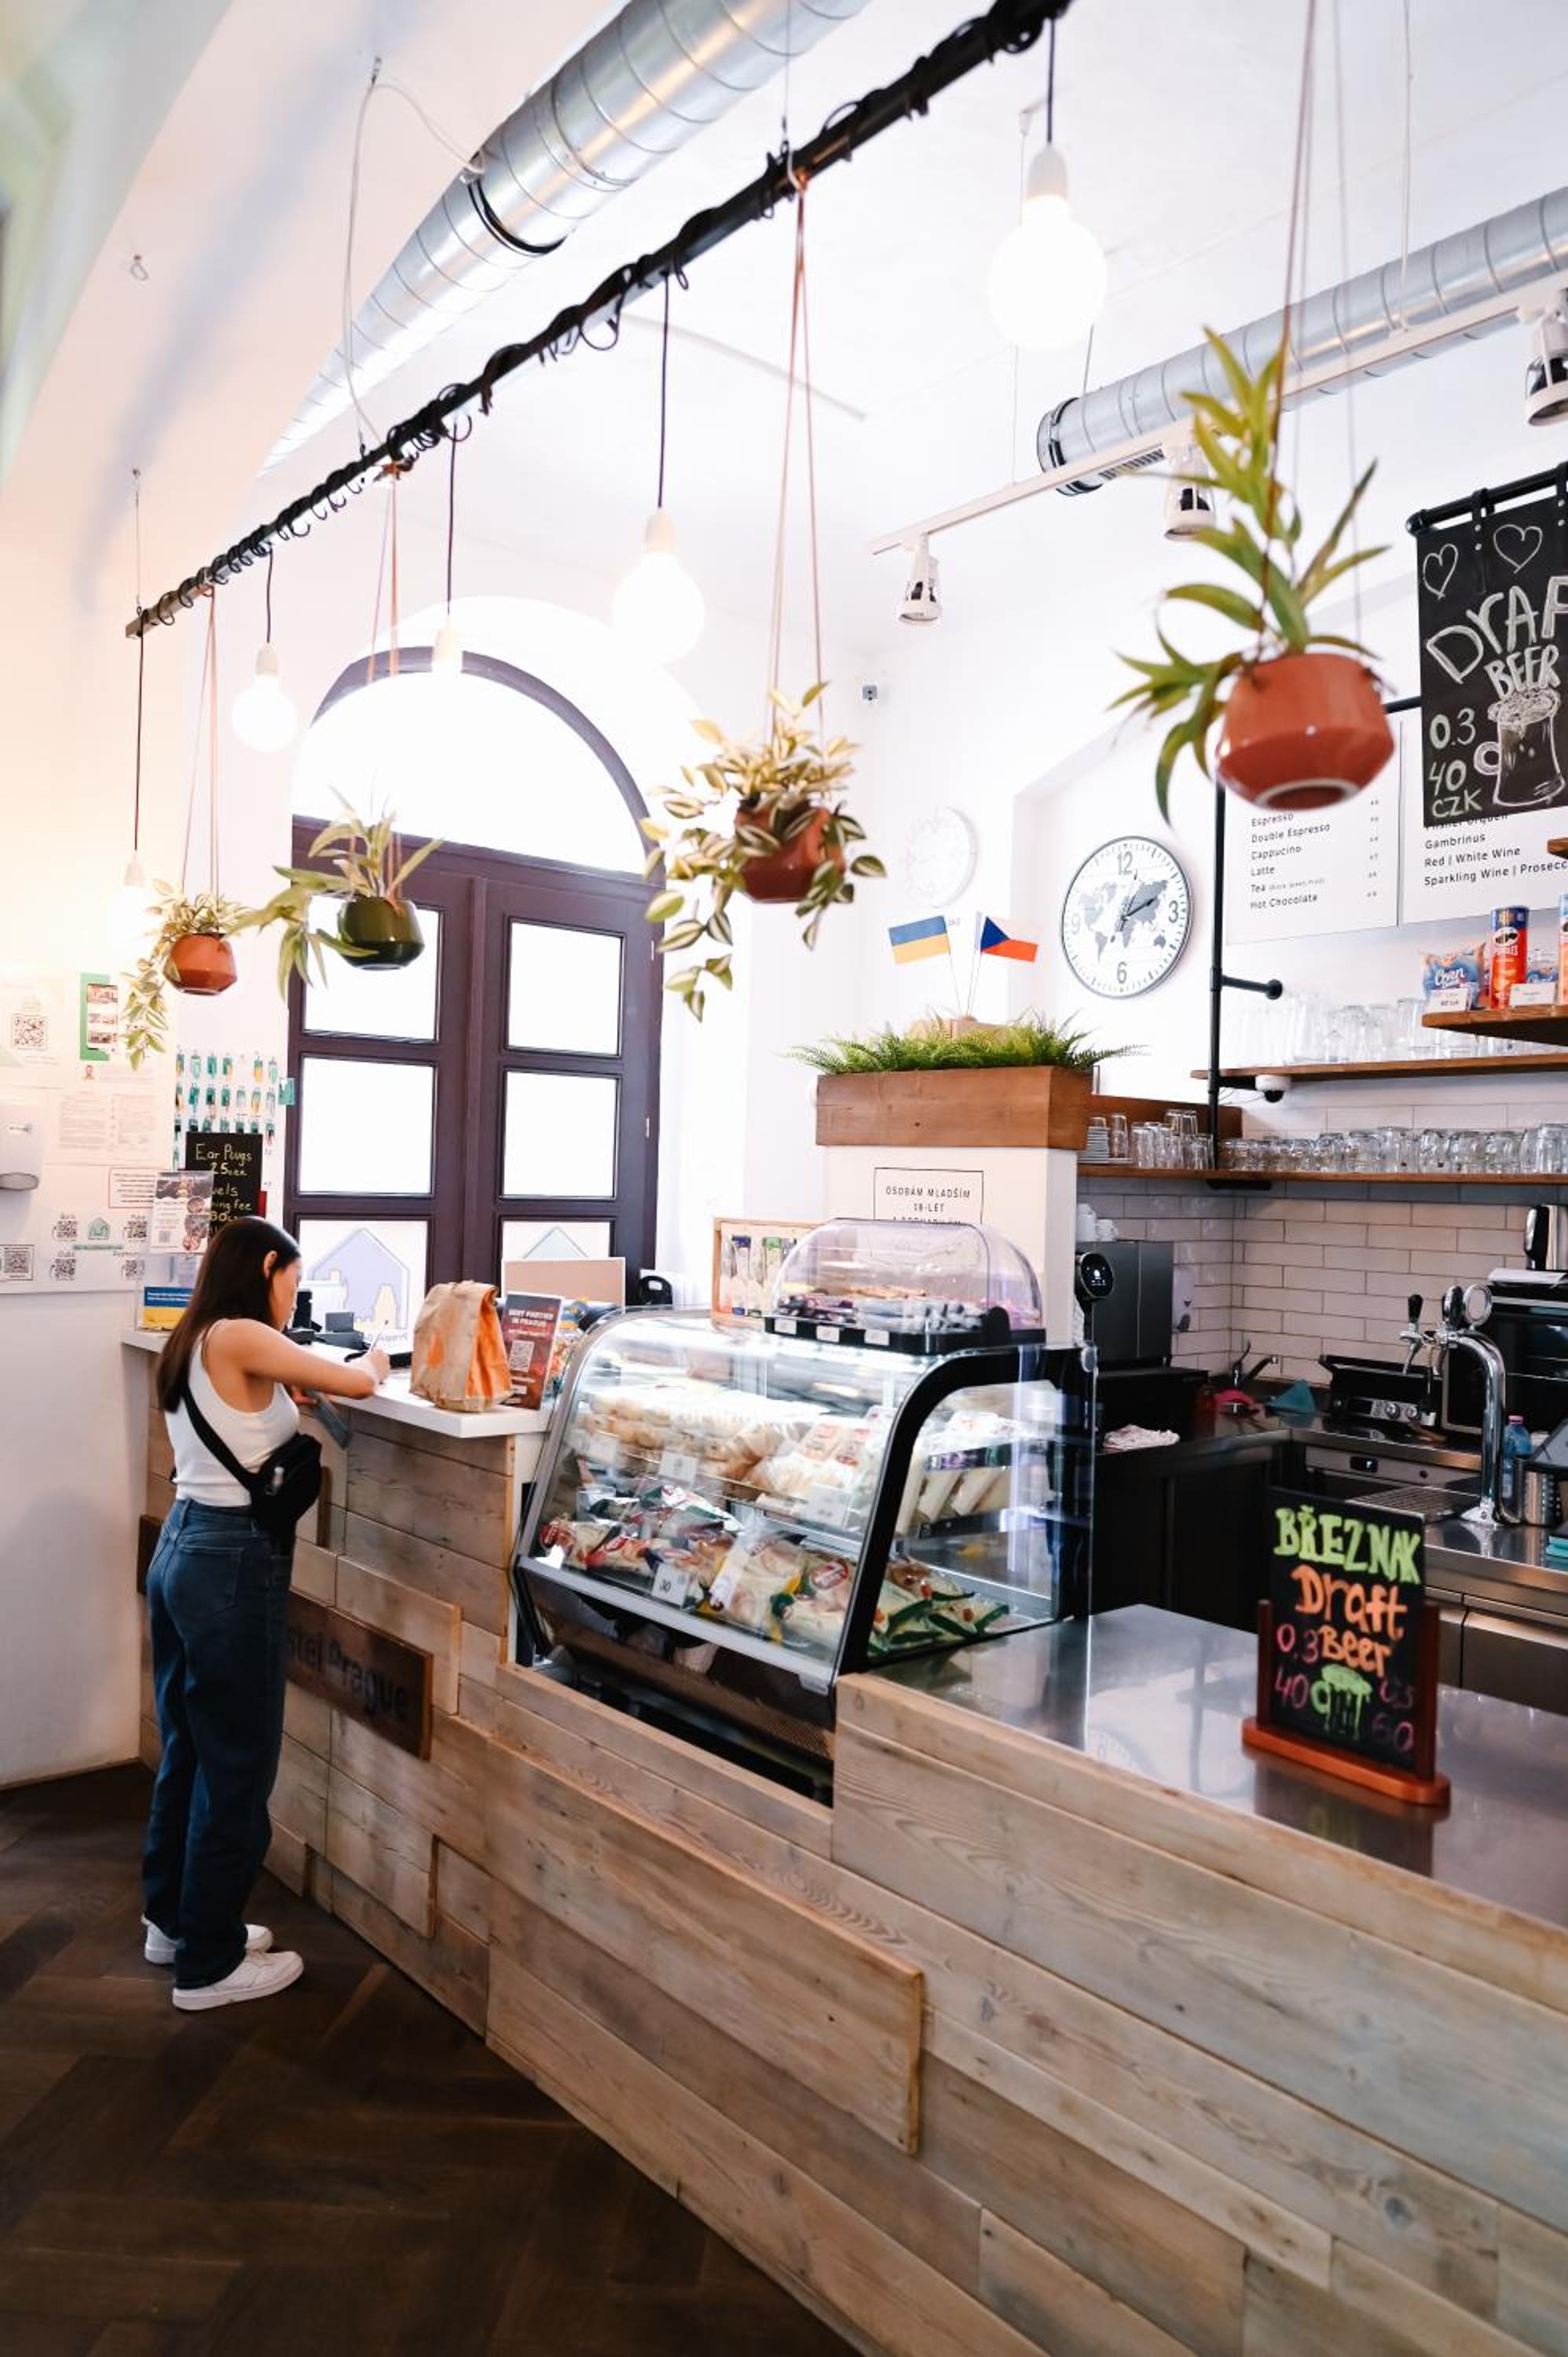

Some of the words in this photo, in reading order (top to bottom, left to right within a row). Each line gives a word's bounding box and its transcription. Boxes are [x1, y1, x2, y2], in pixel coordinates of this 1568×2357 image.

[1484, 644, 1561, 702] BEER
[1429, 708, 1476, 750] 0.3
[1428, 759, 1467, 796] 40
[1432, 789, 1482, 818] CZK
[1251, 812, 1294, 827] Espresso
[1251, 830, 1284, 843] Double
[1288, 823, 1330, 838] Espresso
[1425, 834, 1486, 849] Gambrinus
[1117, 852, 1133, 875] 12
[1424, 856, 1445, 867] Red
[1456, 852, 1488, 863] White
[1492, 847, 1520, 859] Wine
[1251, 866, 1275, 877] Latte
[1424, 871, 1476, 887] Sparkling
[1481, 867, 1509, 879] Wine
[1520, 860, 1568, 874] Prosecc
[1251, 884, 1266, 893] Tea
[1168, 900, 1178, 923] 3
[1250, 900, 1266, 910] Hot
[1270, 893, 1317, 908] Chocolate
[1117, 961, 1127, 984] 6
[196, 1143, 221, 1160] Ear
[885, 1185, 923, 1196] OSOBÁM
[1291, 1564, 1409, 1641] Draft
[1276, 1623, 1319, 1665] 0.3
[1318, 1625, 1392, 1677] Beer
[1273, 1666, 1309, 1710] 40
